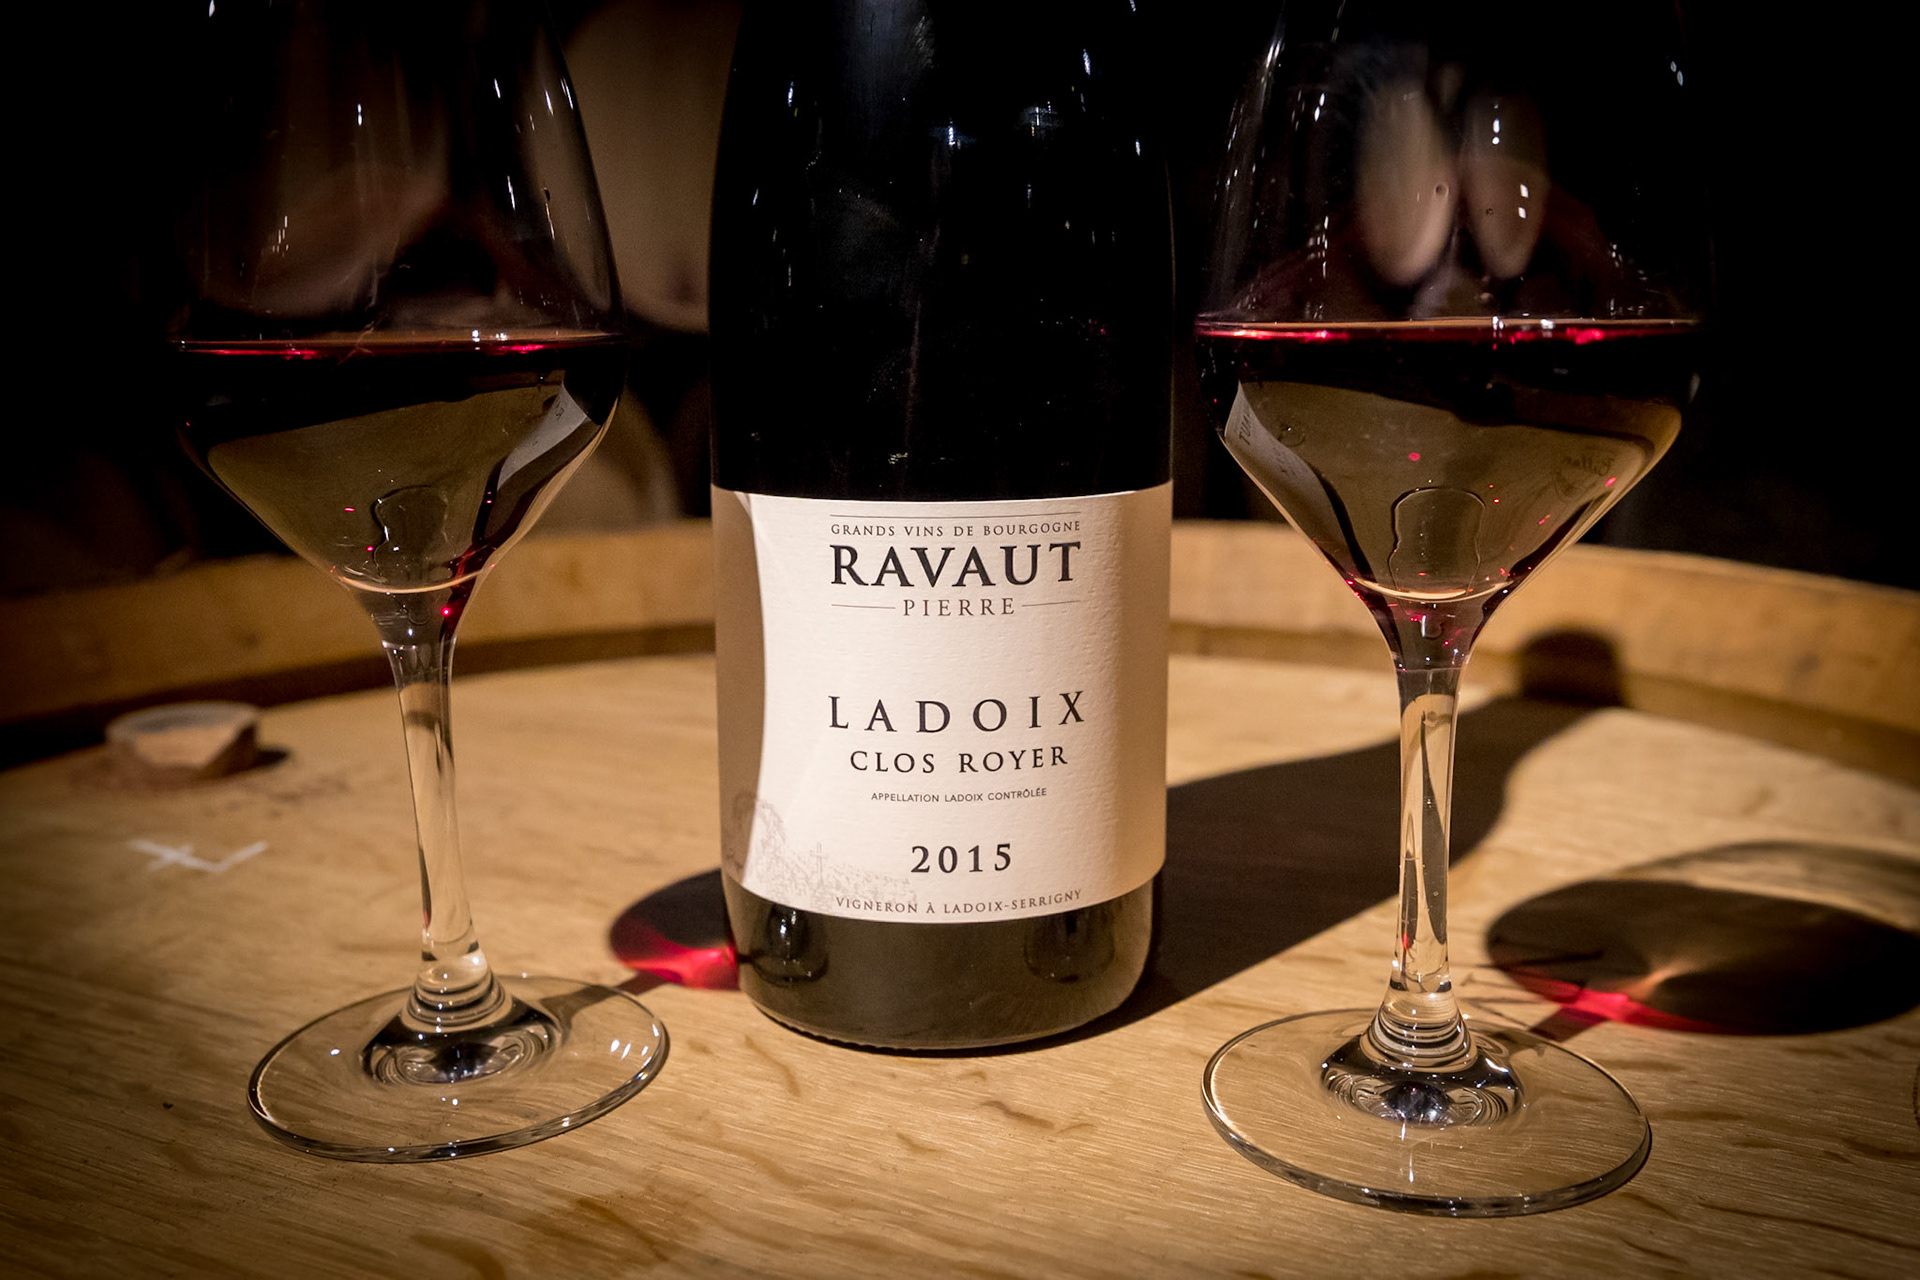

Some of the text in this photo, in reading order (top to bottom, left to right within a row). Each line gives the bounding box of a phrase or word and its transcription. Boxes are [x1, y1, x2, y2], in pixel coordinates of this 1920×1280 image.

[830, 521, 1081, 538] GRANDS VINS DE BOURGOGNE
[830, 541, 1081, 589] RAVAUT
[903, 598, 1014, 616] PIERRE
[828, 690, 1085, 733] LADOIX
[850, 746, 1069, 774] CLOS ROYER
[871, 787, 1047, 803] APPELLATION LADOIX CONTRÔLÉE
[911, 843, 1011, 873] 2015
[836, 891, 1083, 914] VIGNERON À LADOIX-SERRIGNY
